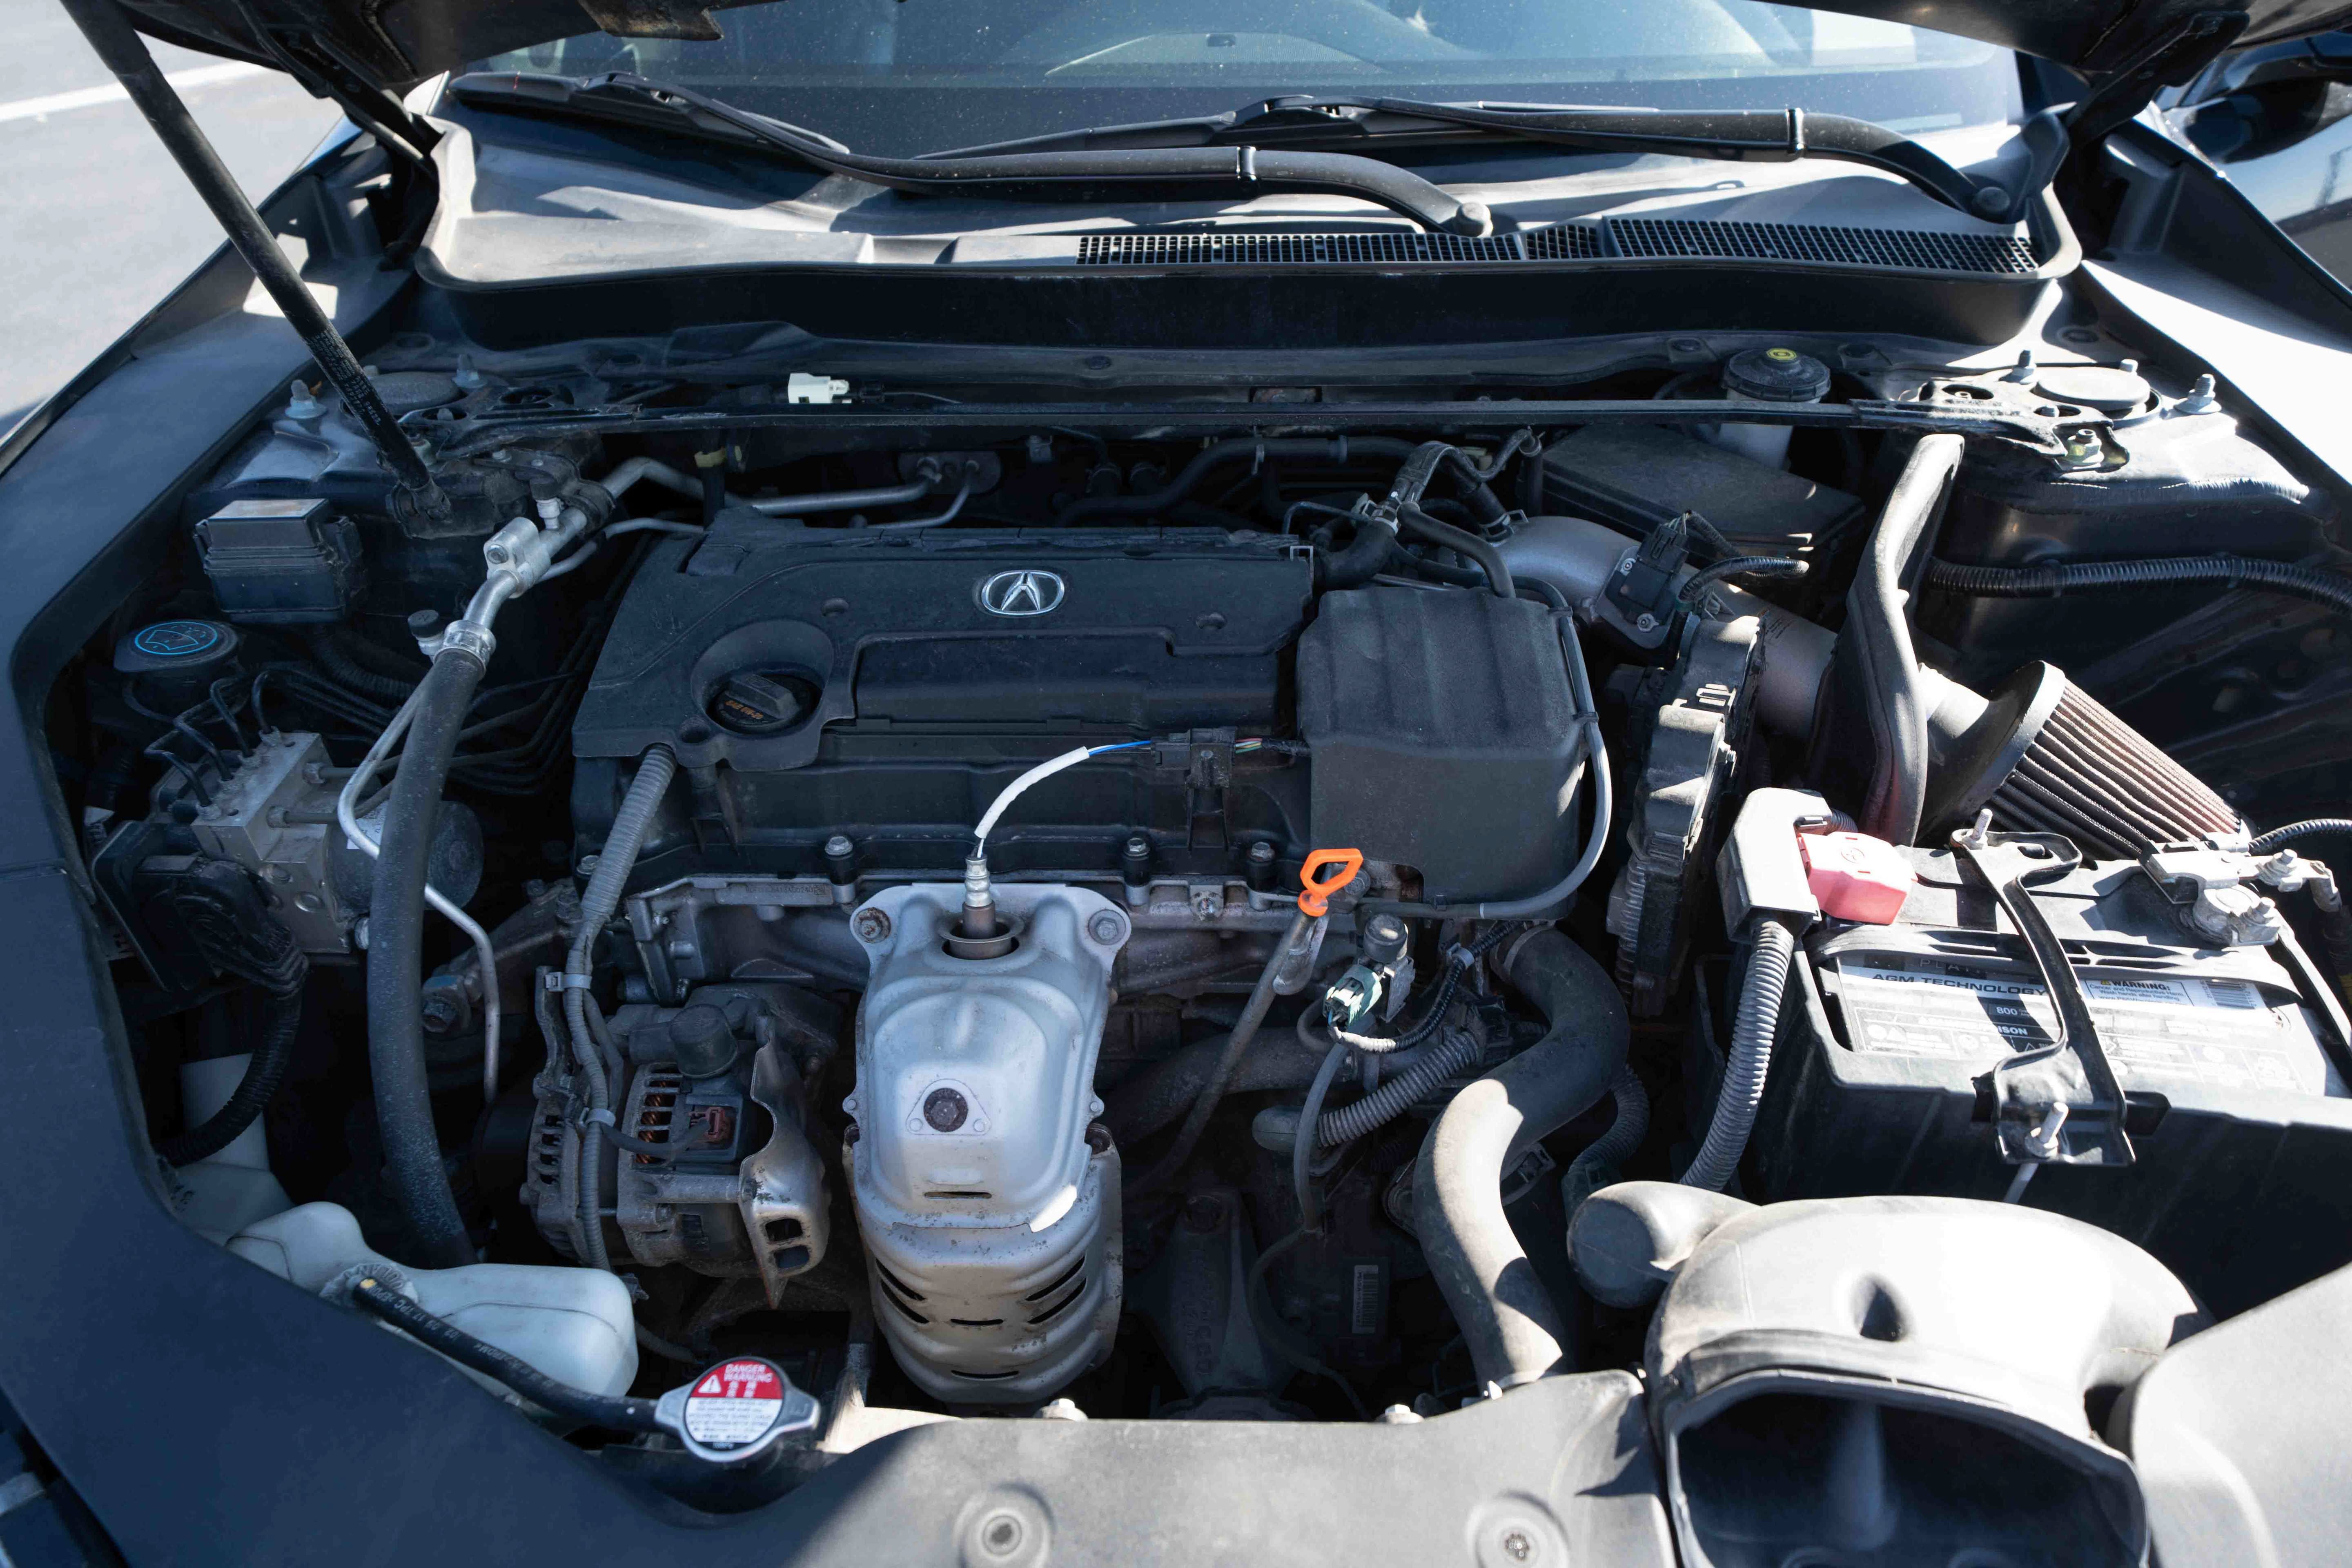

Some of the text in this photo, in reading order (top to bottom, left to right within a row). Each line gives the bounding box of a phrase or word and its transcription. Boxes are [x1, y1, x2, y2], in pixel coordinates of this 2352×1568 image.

[1872, 973, 2046, 996] AGM TECHNOLOGY
[2112, 980, 2171, 991] WARNING:
[1996, 1007, 2018, 1016] 800
[726, 1363, 766, 1373] DANGER
